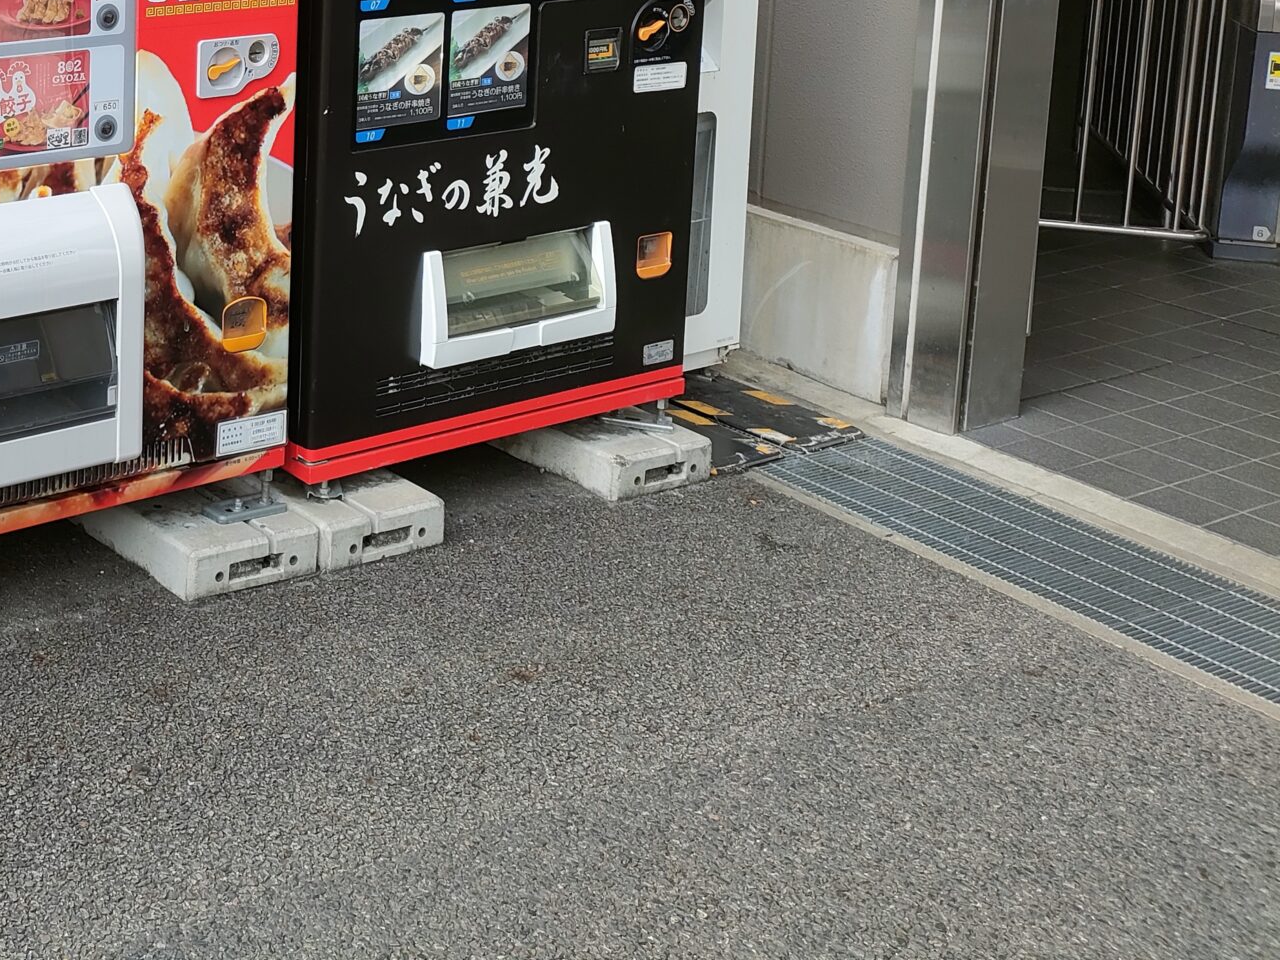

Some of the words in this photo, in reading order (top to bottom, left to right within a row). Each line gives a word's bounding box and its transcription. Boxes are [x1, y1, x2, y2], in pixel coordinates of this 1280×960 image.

[370, 0, 381, 9] 07
[57, 60, 82, 73] 802
[52, 73, 86, 84] GYOZA
[457, 119, 465, 127] 11
[344, 144, 559, 238] うなぎの兼光
[1257, 229, 1265, 238] 6
